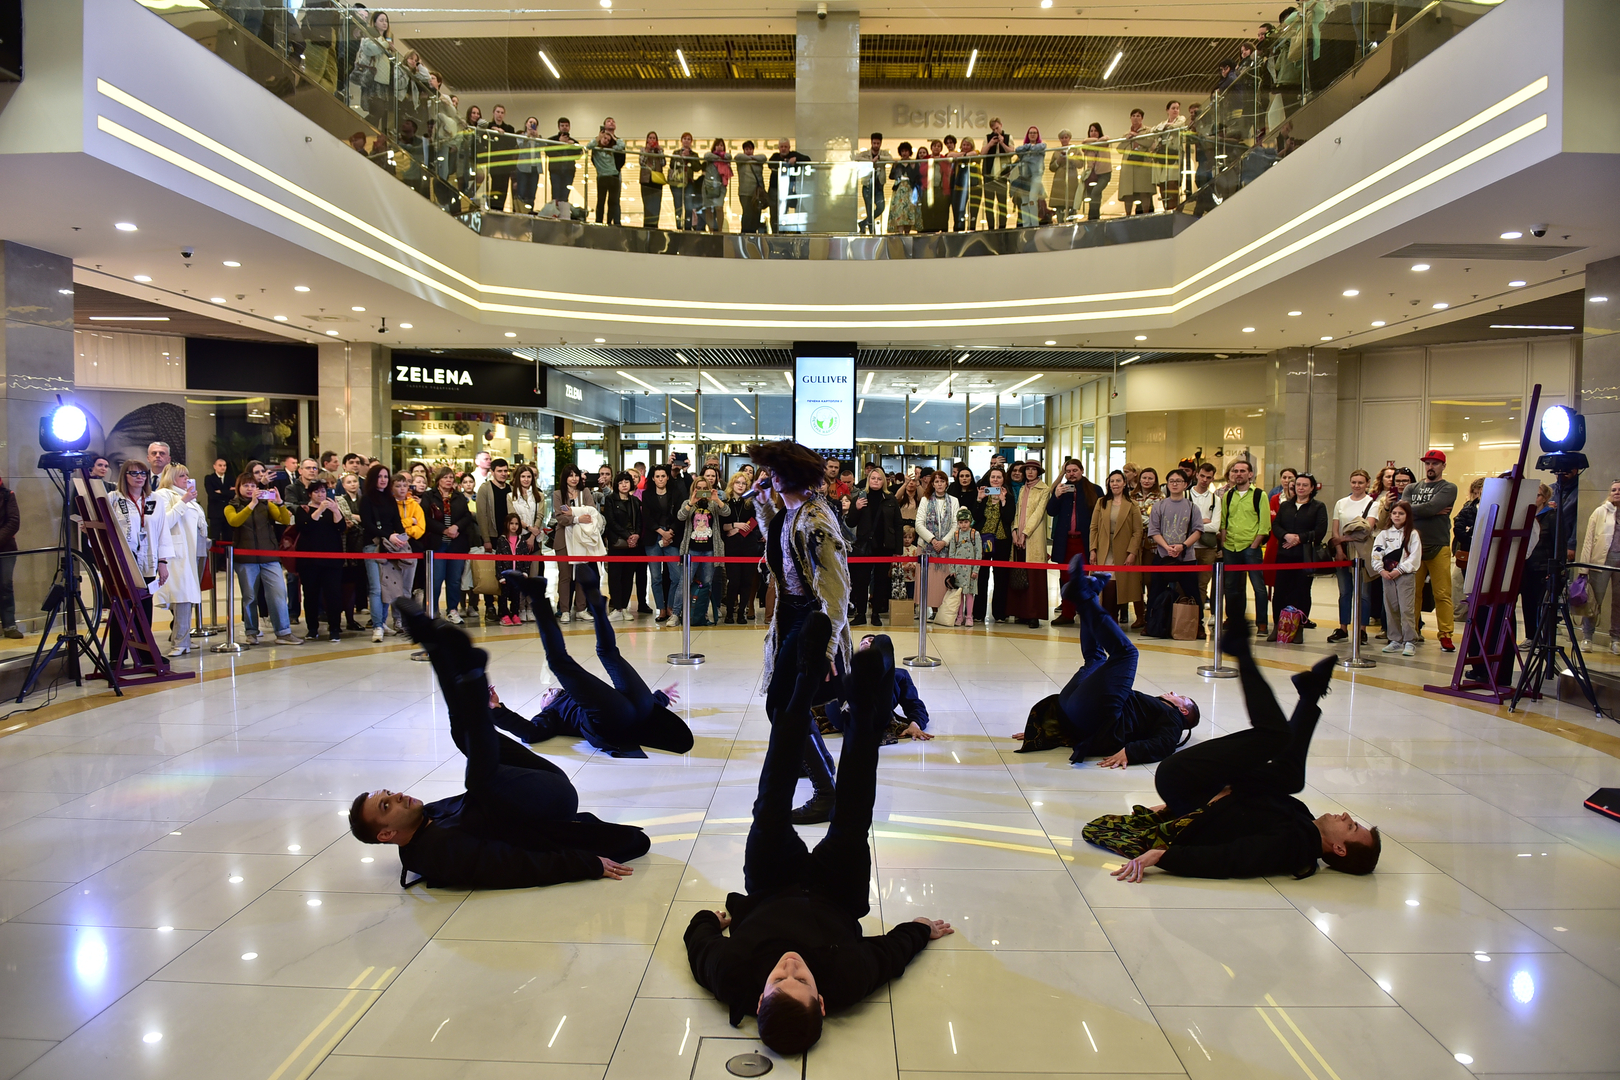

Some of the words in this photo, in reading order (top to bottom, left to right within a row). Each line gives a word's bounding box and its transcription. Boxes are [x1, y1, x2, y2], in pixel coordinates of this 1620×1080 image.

[892, 104, 988, 129] Bershka
[396, 365, 473, 386] ZELENA
[802, 375, 847, 383] GULLIVER
